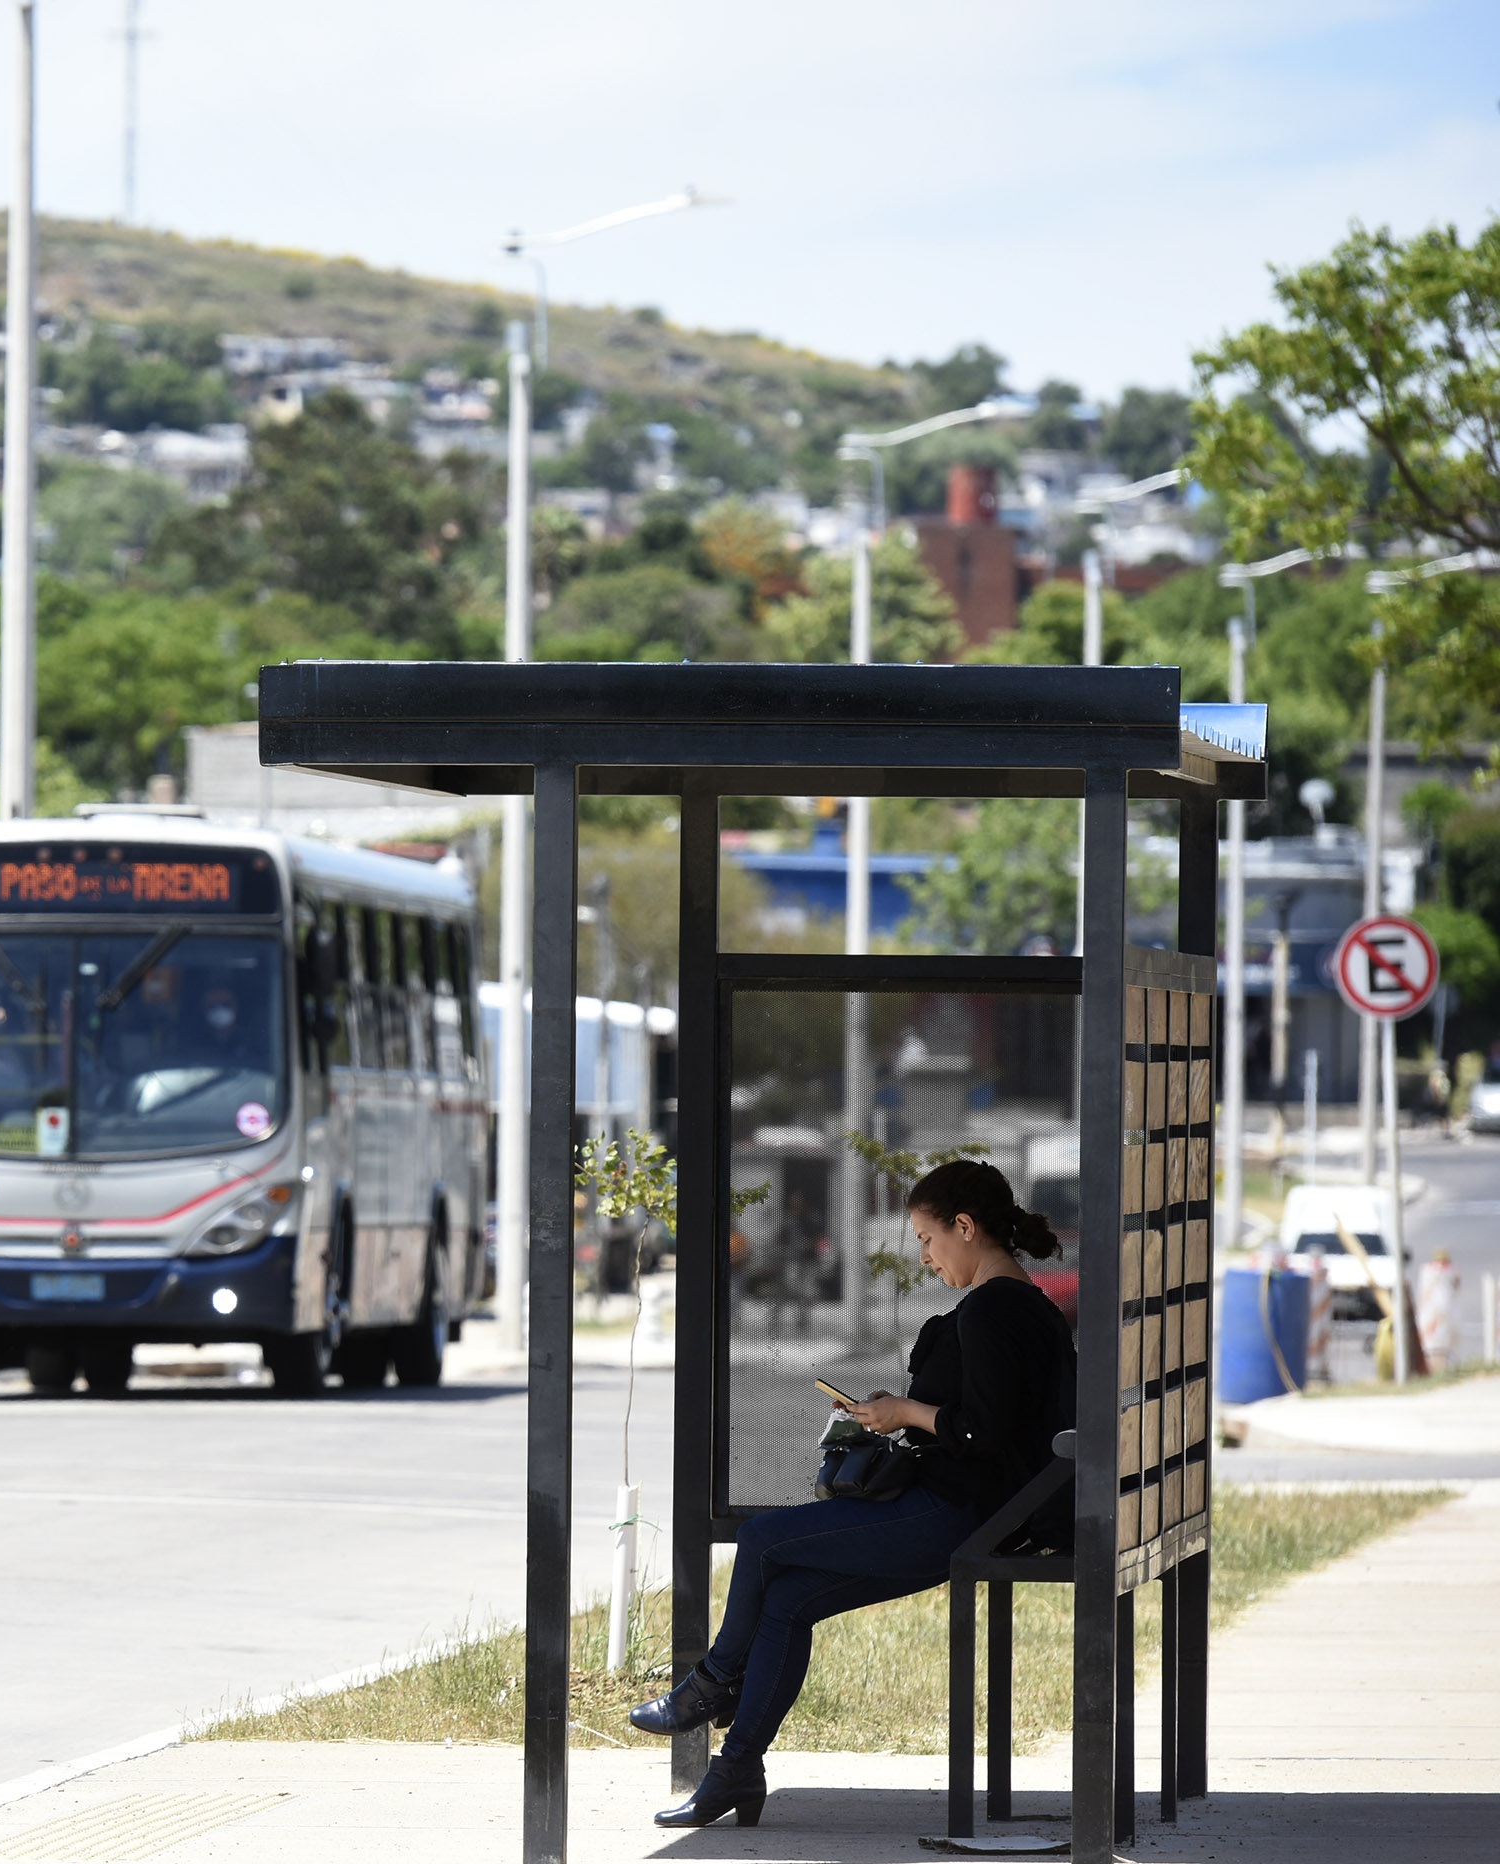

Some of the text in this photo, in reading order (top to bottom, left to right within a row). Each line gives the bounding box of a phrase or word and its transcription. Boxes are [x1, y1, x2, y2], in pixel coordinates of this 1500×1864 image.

[1, 862, 77, 901] PASO
[132, 862, 230, 900] ARENA
[1368, 937, 1407, 993] E
